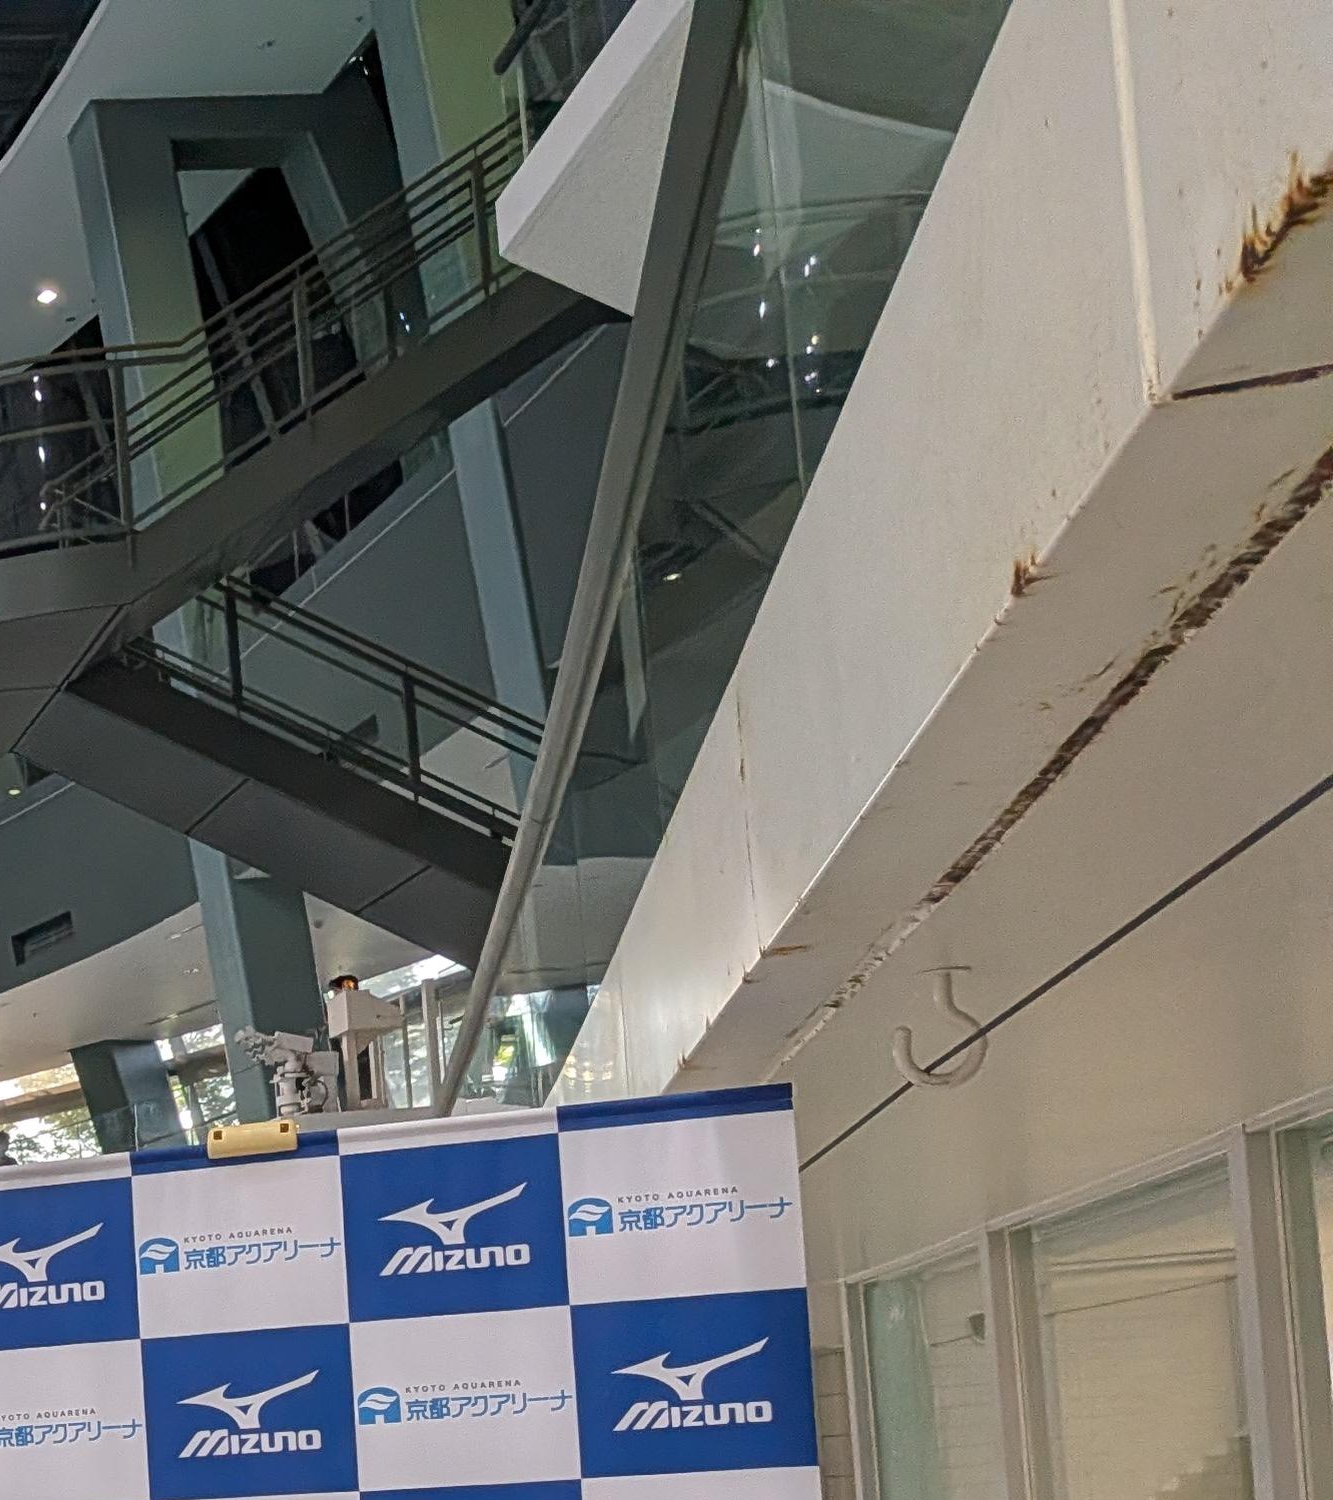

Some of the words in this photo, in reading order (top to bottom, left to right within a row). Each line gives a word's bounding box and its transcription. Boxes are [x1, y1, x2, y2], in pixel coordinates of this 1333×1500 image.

[617, 1193, 660, 1204] KYOTO
[667, 1185, 739, 1200] AQUARENA
[618, 1197, 792, 1231] 京都アクアリーナ
[183, 1233, 222, 1244] KYOTO
[228, 1226, 293, 1240] AQUARENA
[184, 1238, 341, 1268] 京都アクアリーナ
[380, 1244, 530, 1275] MIZUNO
[405, 1384, 446, 1394] KYOTO
[452, 1379, 521, 1391] AQUARENA
[36, 1407, 96, 1419] AQUARENA
[406, 1390, 572, 1420] 京都アクアリーナ
[614, 1401, 772, 1431] MIZUNO
[179, 1429, 321, 1458] MIZUNO
